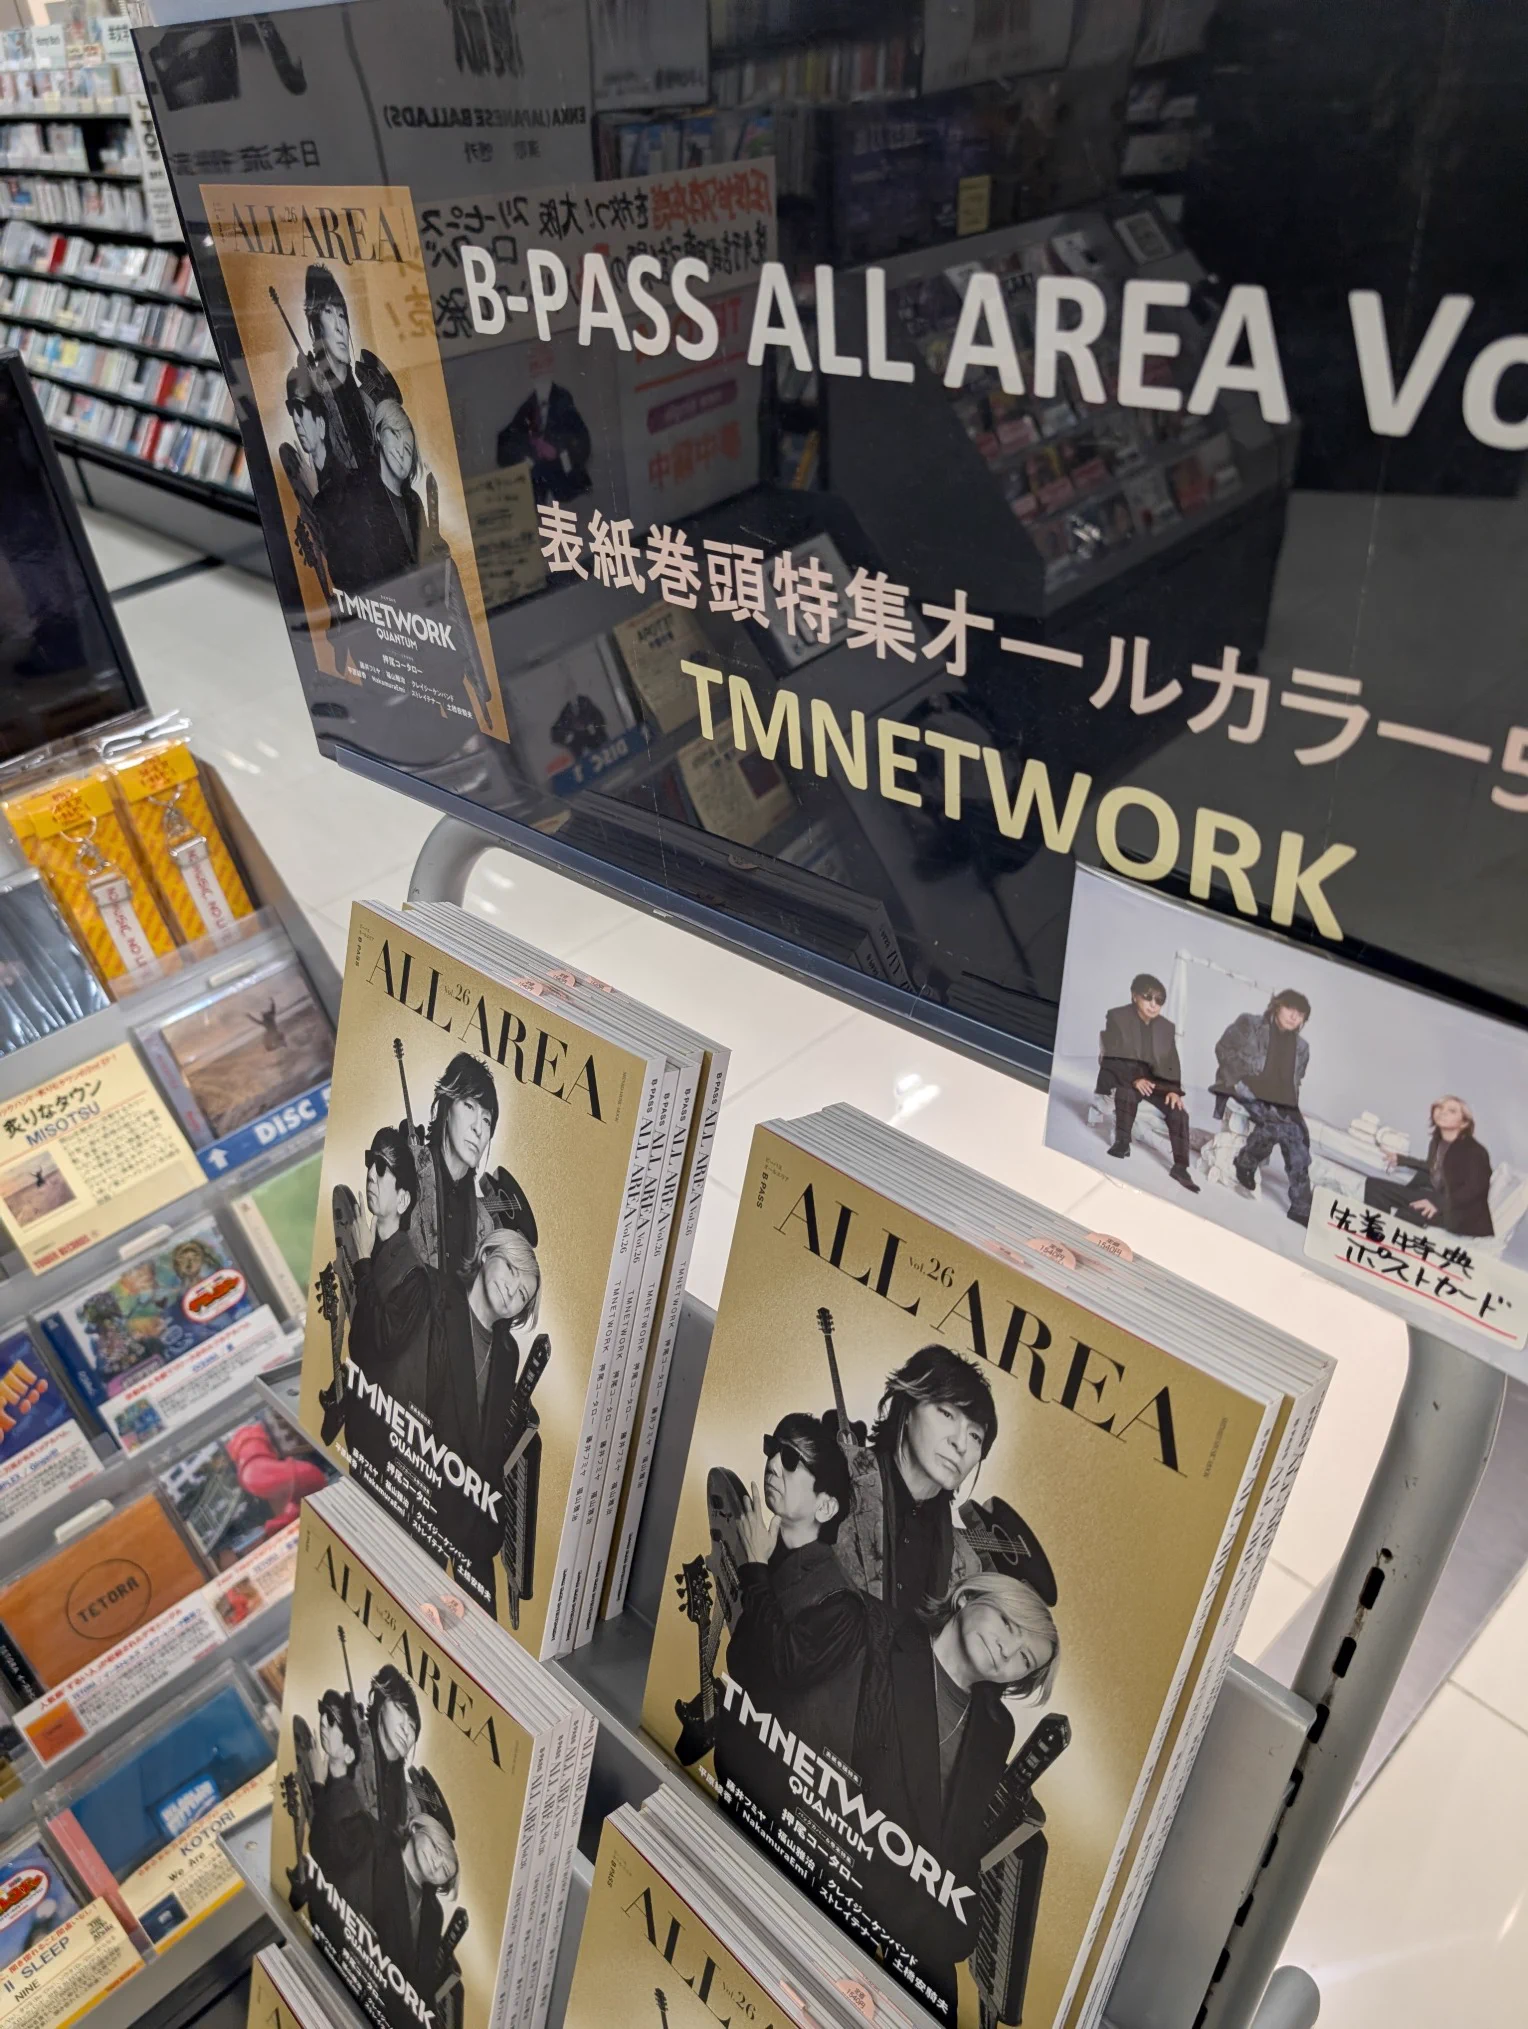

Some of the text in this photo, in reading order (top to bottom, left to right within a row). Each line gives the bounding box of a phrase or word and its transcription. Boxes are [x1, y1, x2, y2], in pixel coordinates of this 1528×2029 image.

[231, 202, 297, 257] ALL
[301, 204, 407, 266] AREA
[460, 244, 719, 362] B-PASS
[747, 261, 915, 383] ALL
[943, 271, 1292, 425] AREA
[332, 587, 457, 651] TMNETWORK
[376, 627, 419, 651] QUANTUM
[680, 658, 1358, 941] TMNETWORK
[365, 939, 453, 1034] ALL
[457, 995, 608, 1124] AREA
[2, 1079, 103, 1139] 炙りなタウン
[25, 1101, 102, 1147] MISOTSU
[251, 1099, 318, 1146] DISC
[635, 1116, 656, 1159] ALL
[700, 1107, 719, 1148] ALL
[648, 1129, 669, 1171] ALL
[669, 1124, 689, 1166] ALL
[622, 1163, 645, 1221] AREA
[636, 1175, 658, 1233] AREA
[657, 1169, 678, 1226] AREA
[688, 1150, 710, 1206] AREA
[668, 1260, 686, 1329] TMNETWORK
[1346, 1237, 1513, 1319] ポストカード
[602, 1280, 621, 1353] TMNETWORK
[616, 1289, 635, 1360] TMNETWORK
[637, 1282, 655, 1353] TMNETWORK
[772, 1181, 1189, 1480] ALL AREA
[345, 1356, 503, 1524] TMNETWORK
[388, 1431, 443, 1490] QUANTUM
[1228, 1474, 1257, 1529] ALL
[1201, 1531, 1237, 1602] AREA
[75, 1576, 140, 1624] TETORA
[314, 1543, 506, 1774] ALL AREA
[720, 1670, 977, 1927] TMNETWORK
[788, 1774, 875, 1862] QUANTUM
[180, 1810, 237, 1857] KOTORI
[780, 1807, 864, 1890] 押尾コータロー
[168, 1851, 206, 1883] We Are
[726, 1777, 919, 1967] 藤井フミヤ 福山雅治 クレイジーケンバンド
[303, 1851, 436, 2029] TMNETWORK
[741, 1810, 809, 1880] NakamuraEmi
[818, 1886, 881, 1949] ストレイテナー
[891, 1956, 950, 2016] 土橋安騎夫
[20, 1936, 71, 1979] SLEEP
[14, 1979, 41, 2004] NINE
